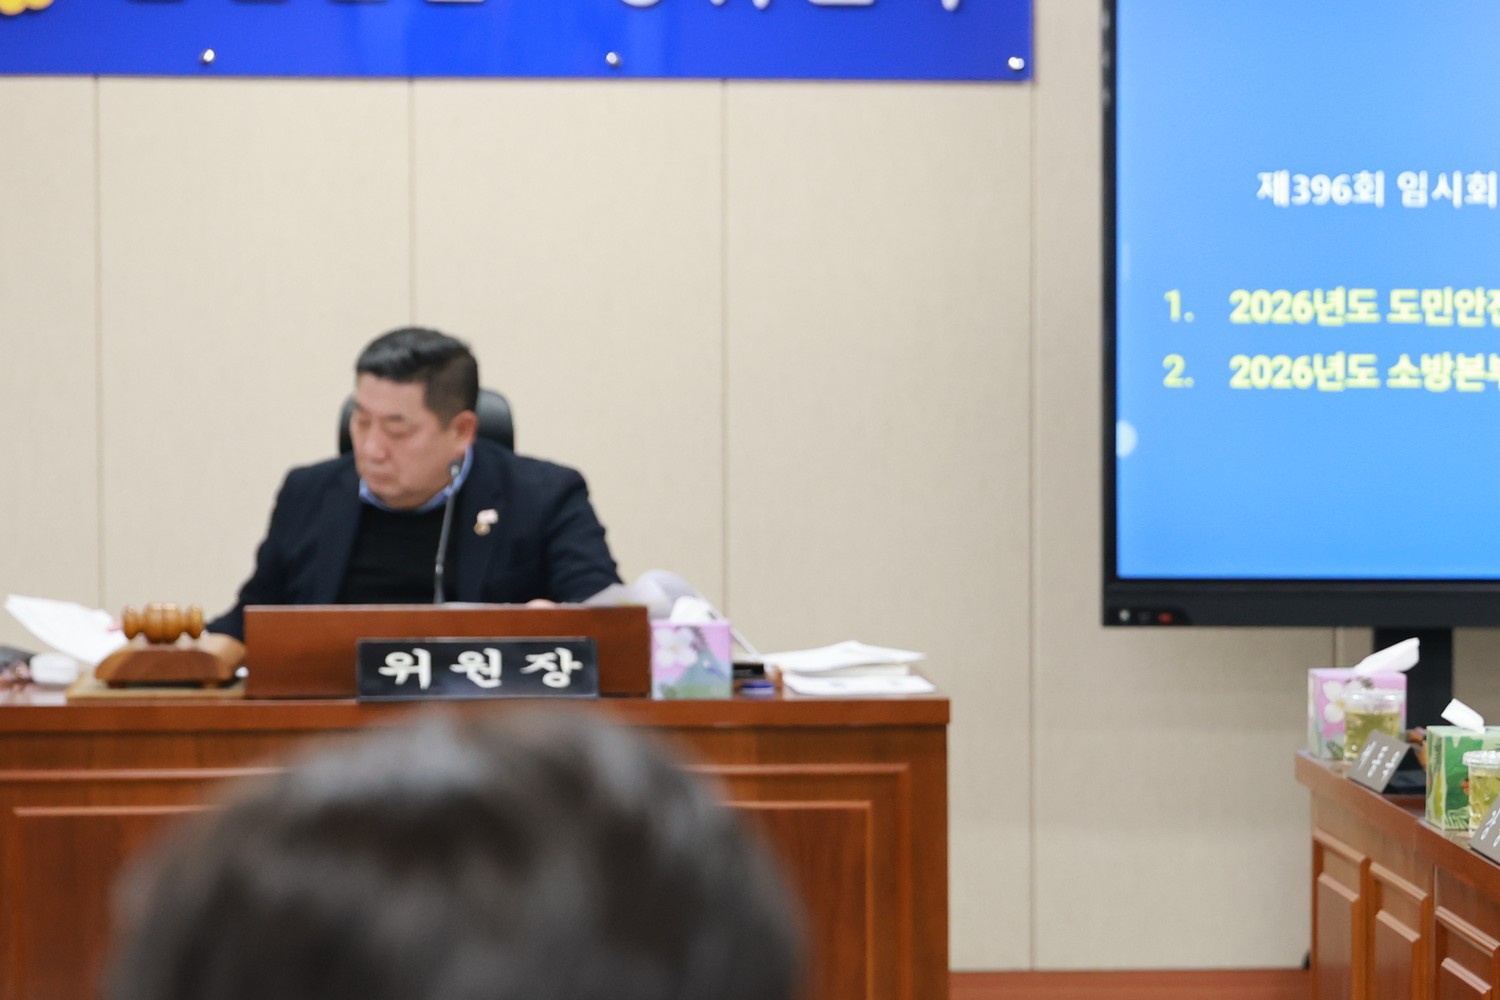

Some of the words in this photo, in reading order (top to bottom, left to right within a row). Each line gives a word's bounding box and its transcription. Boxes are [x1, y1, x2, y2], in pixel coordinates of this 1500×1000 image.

[1257, 168, 1385, 208] 제396회
[1397, 169, 1499, 209] 임시회
[1163, 289, 1195, 323] 1.
[1228, 286, 1381, 327] 2026년도
[1162, 354, 1195, 389] 2.
[1228, 352, 1381, 392] 2026년도
[377, 647, 583, 690] 위원장
